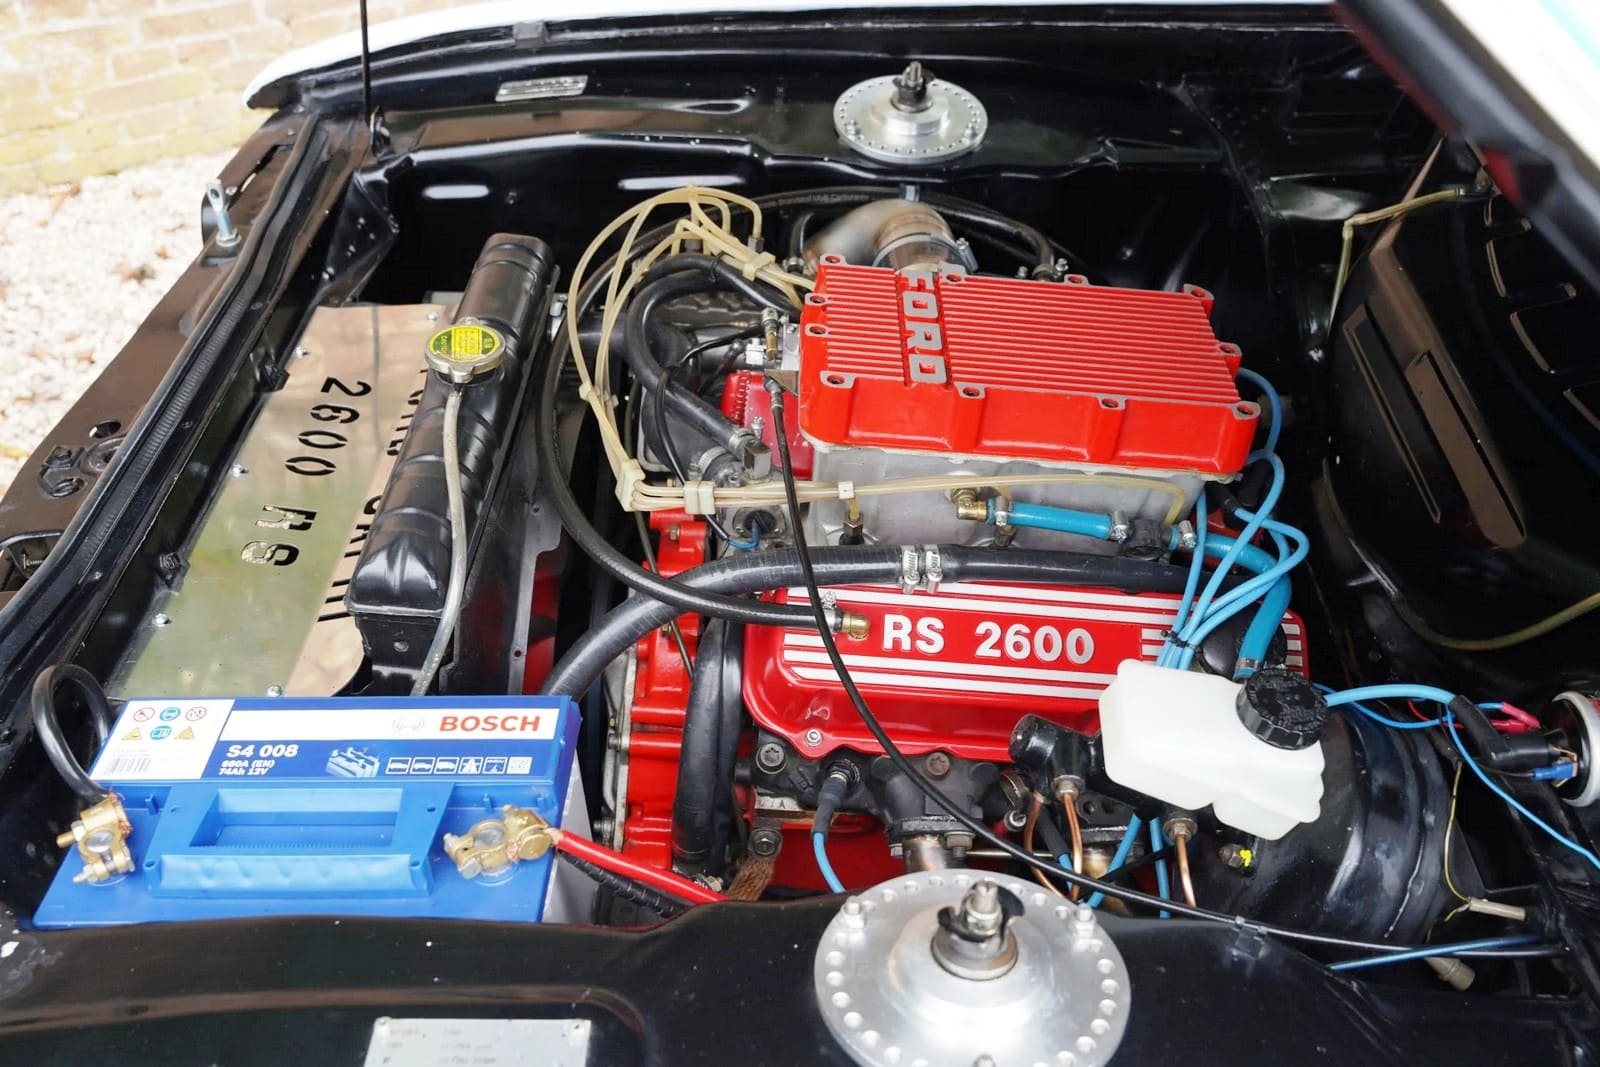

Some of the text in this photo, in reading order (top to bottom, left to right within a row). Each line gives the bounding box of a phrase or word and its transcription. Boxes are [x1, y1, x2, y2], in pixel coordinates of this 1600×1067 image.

[902, 268, 947, 384] FORD
[284, 376, 372, 477] 2600
[241, 504, 318, 567] RS
[882, 613, 1095, 665] RS 2600
[439, 715, 541, 733] BOSCH
[226, 744, 299, 758] S4 008
[251, 759, 276, 769] (EN)
[218, 767, 270, 776] 74Ah 12V
